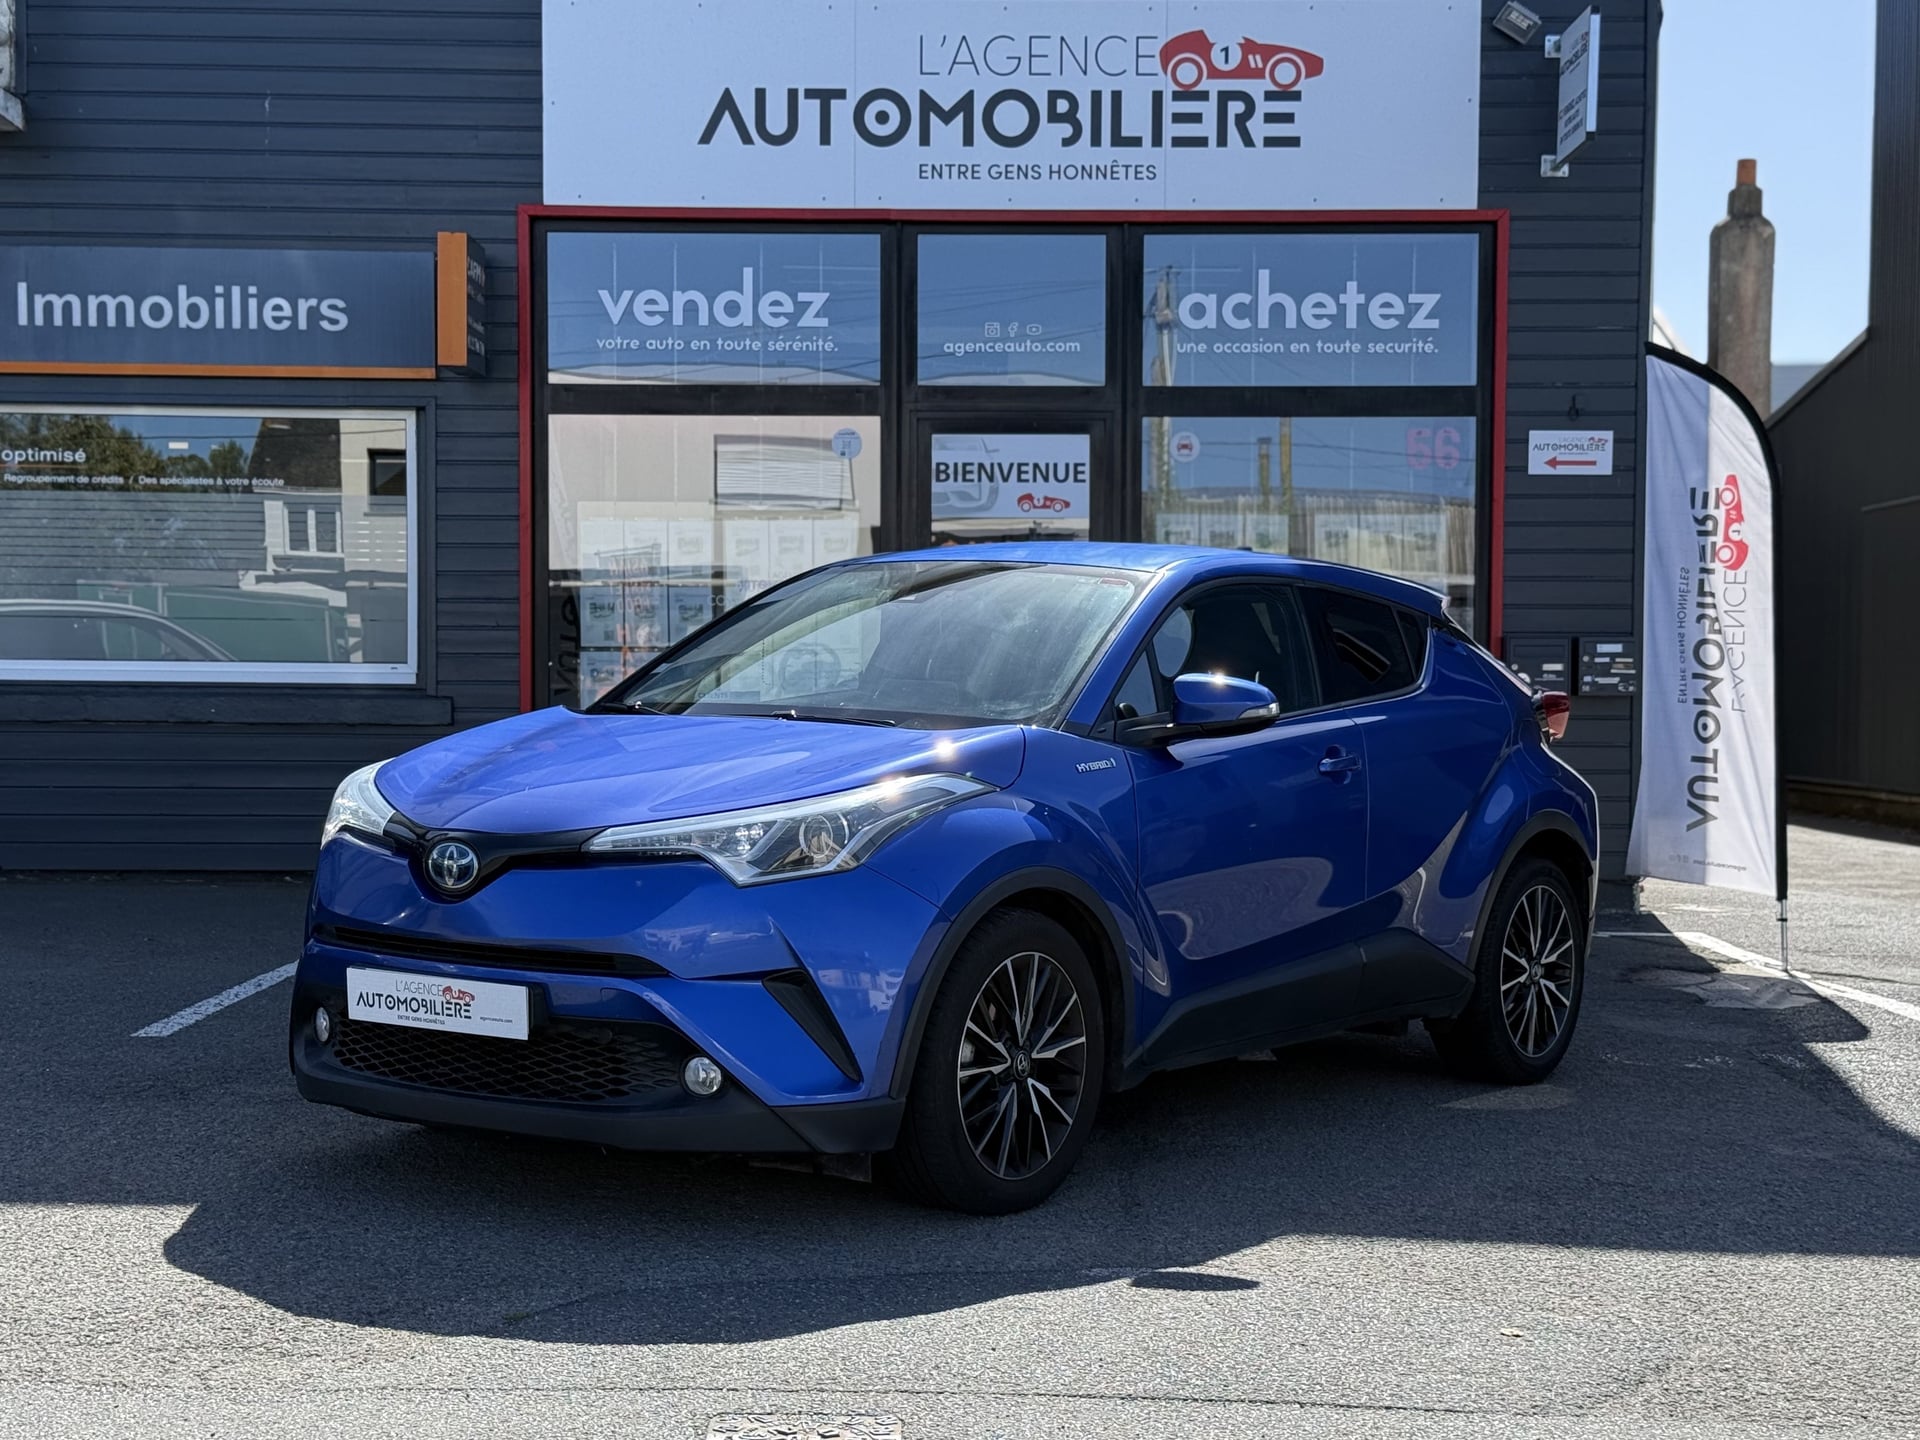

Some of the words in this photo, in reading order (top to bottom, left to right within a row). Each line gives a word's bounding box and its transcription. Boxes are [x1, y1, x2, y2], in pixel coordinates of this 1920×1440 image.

[919, 35, 1158, 77] L'AGENCE
[918, 163, 982, 181] ENTRE
[987, 163, 1042, 181] GENS
[1048, 159, 1157, 181] HONNÊTES
[17, 281, 349, 332] Immobiliers
[597, 266, 830, 328] vendez
[1178, 268, 1442, 330] achetez
[597, 336, 640, 351] votre
[645, 336, 685, 351] auto
[690, 339, 711, 351] en
[716, 337, 762, 351] toute
[767, 335, 839, 352] sérénité.
[943, 338, 1081, 356] agenceauto.com
[1176, 343, 1207, 354] une
[1212, 338, 1284, 354] occasion
[1289, 342, 1310, 354] en
[1315, 339, 1362, 354] toute
[1367, 336, 1439, 354] securité.
[1, 447, 87, 464] optimisé
[3, 473, 74, 485] Regroupement
[76, 475, 89, 484] de
[91, 475, 124, 485] crédits
[138, 475, 157, 485] Des
[160, 475, 214, 486] spécialistes
[216, 475, 223, 486] à
[224, 478, 249, 486] votre
[252, 477, 284, 486] écoute
[935, 461, 1086, 484] BIENVENUE
[395, 979, 443, 997] L'AGENCE
